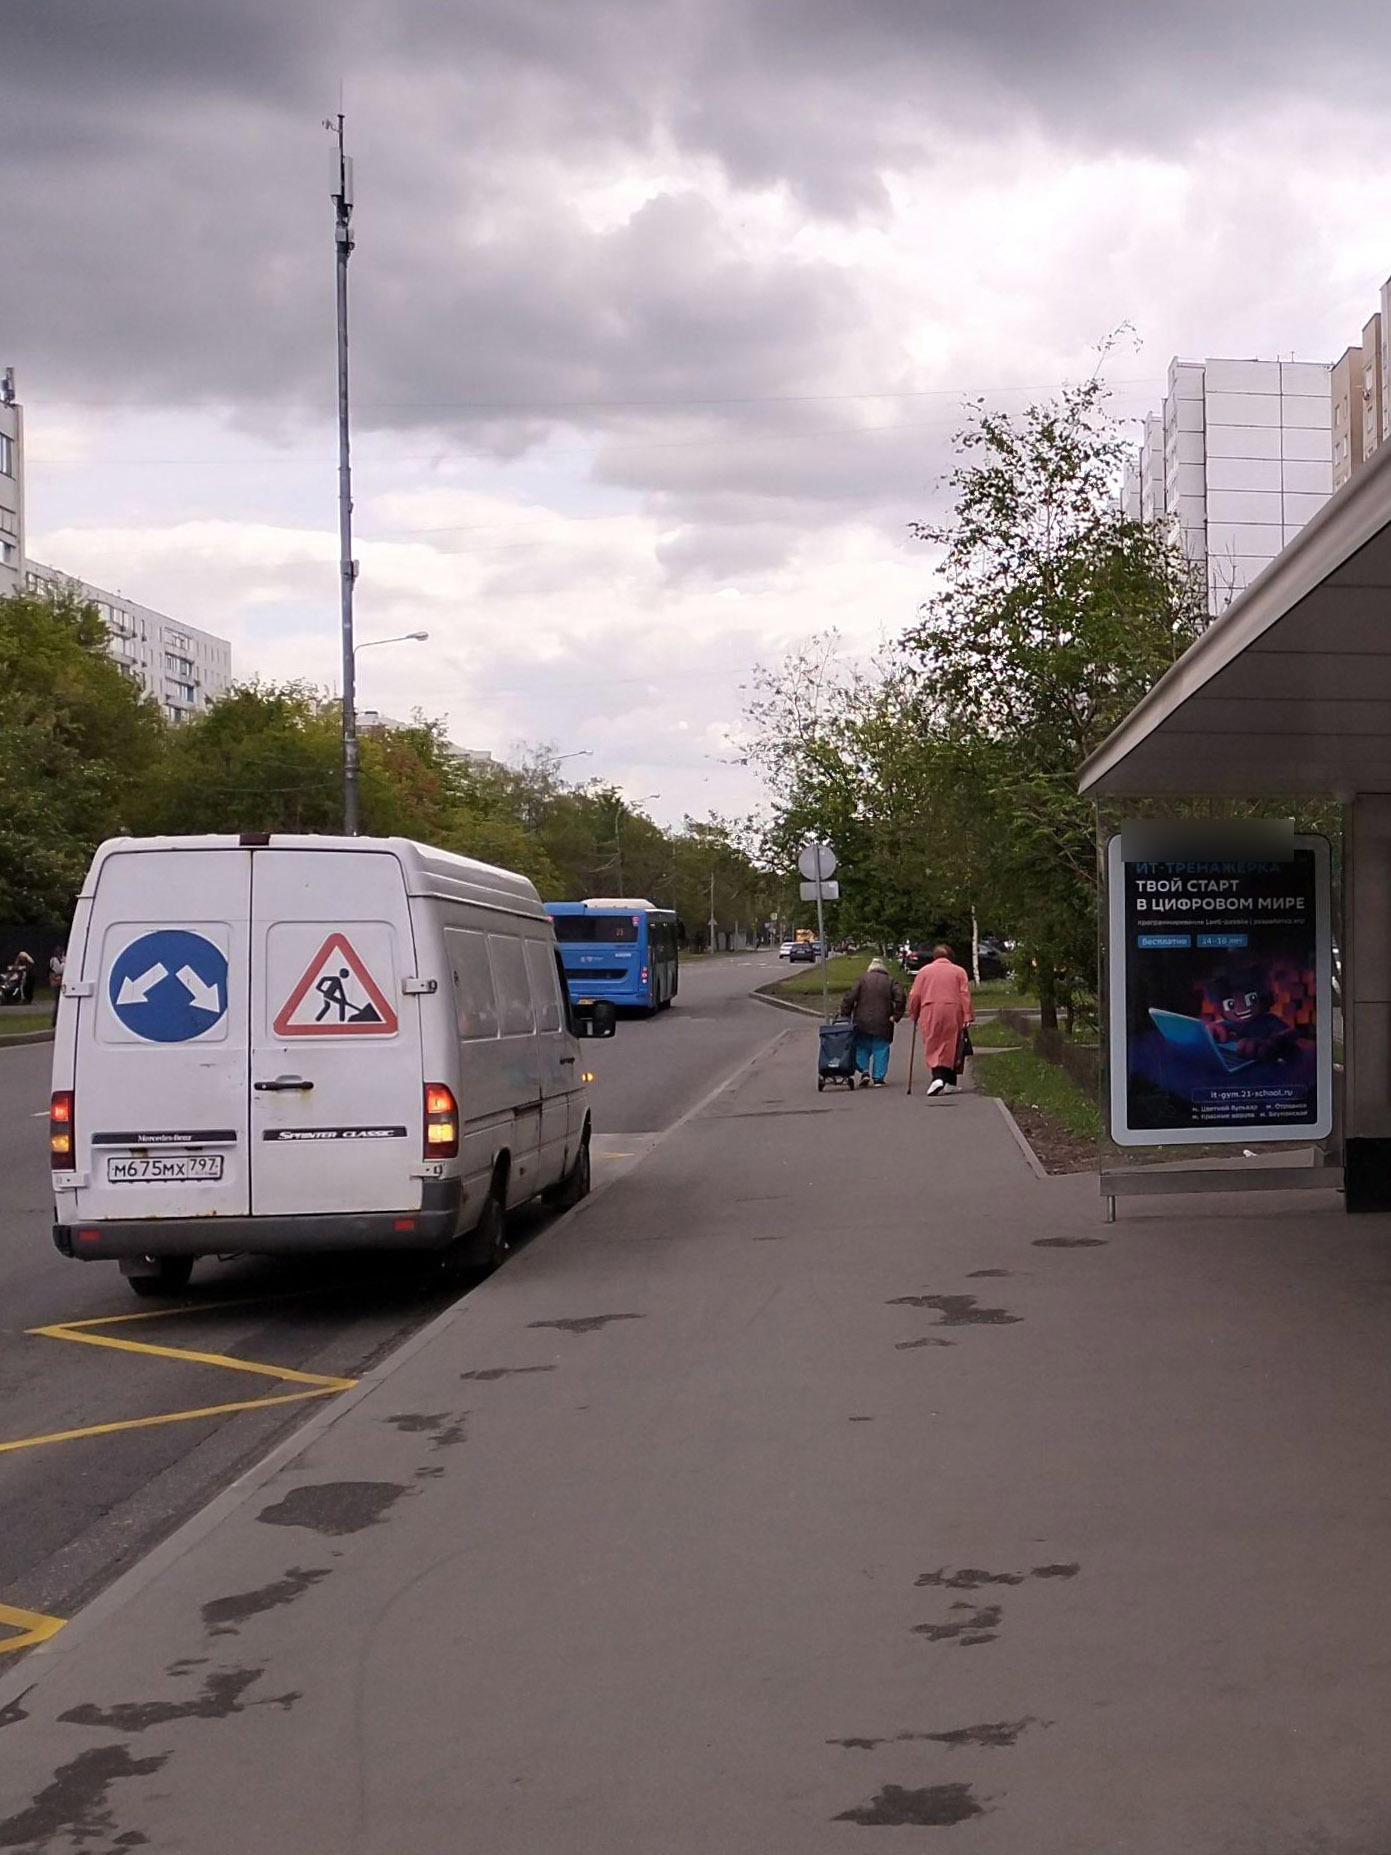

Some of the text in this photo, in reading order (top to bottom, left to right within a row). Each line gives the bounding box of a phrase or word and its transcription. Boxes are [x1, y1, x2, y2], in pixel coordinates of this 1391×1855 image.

[1136, 877, 1240, 892] ТВОЙ СТАРТ
[1136, 897, 1305, 912] В ЦИФРОВОМ МИРЕ
[189, 1158, 217, 1171] 797
